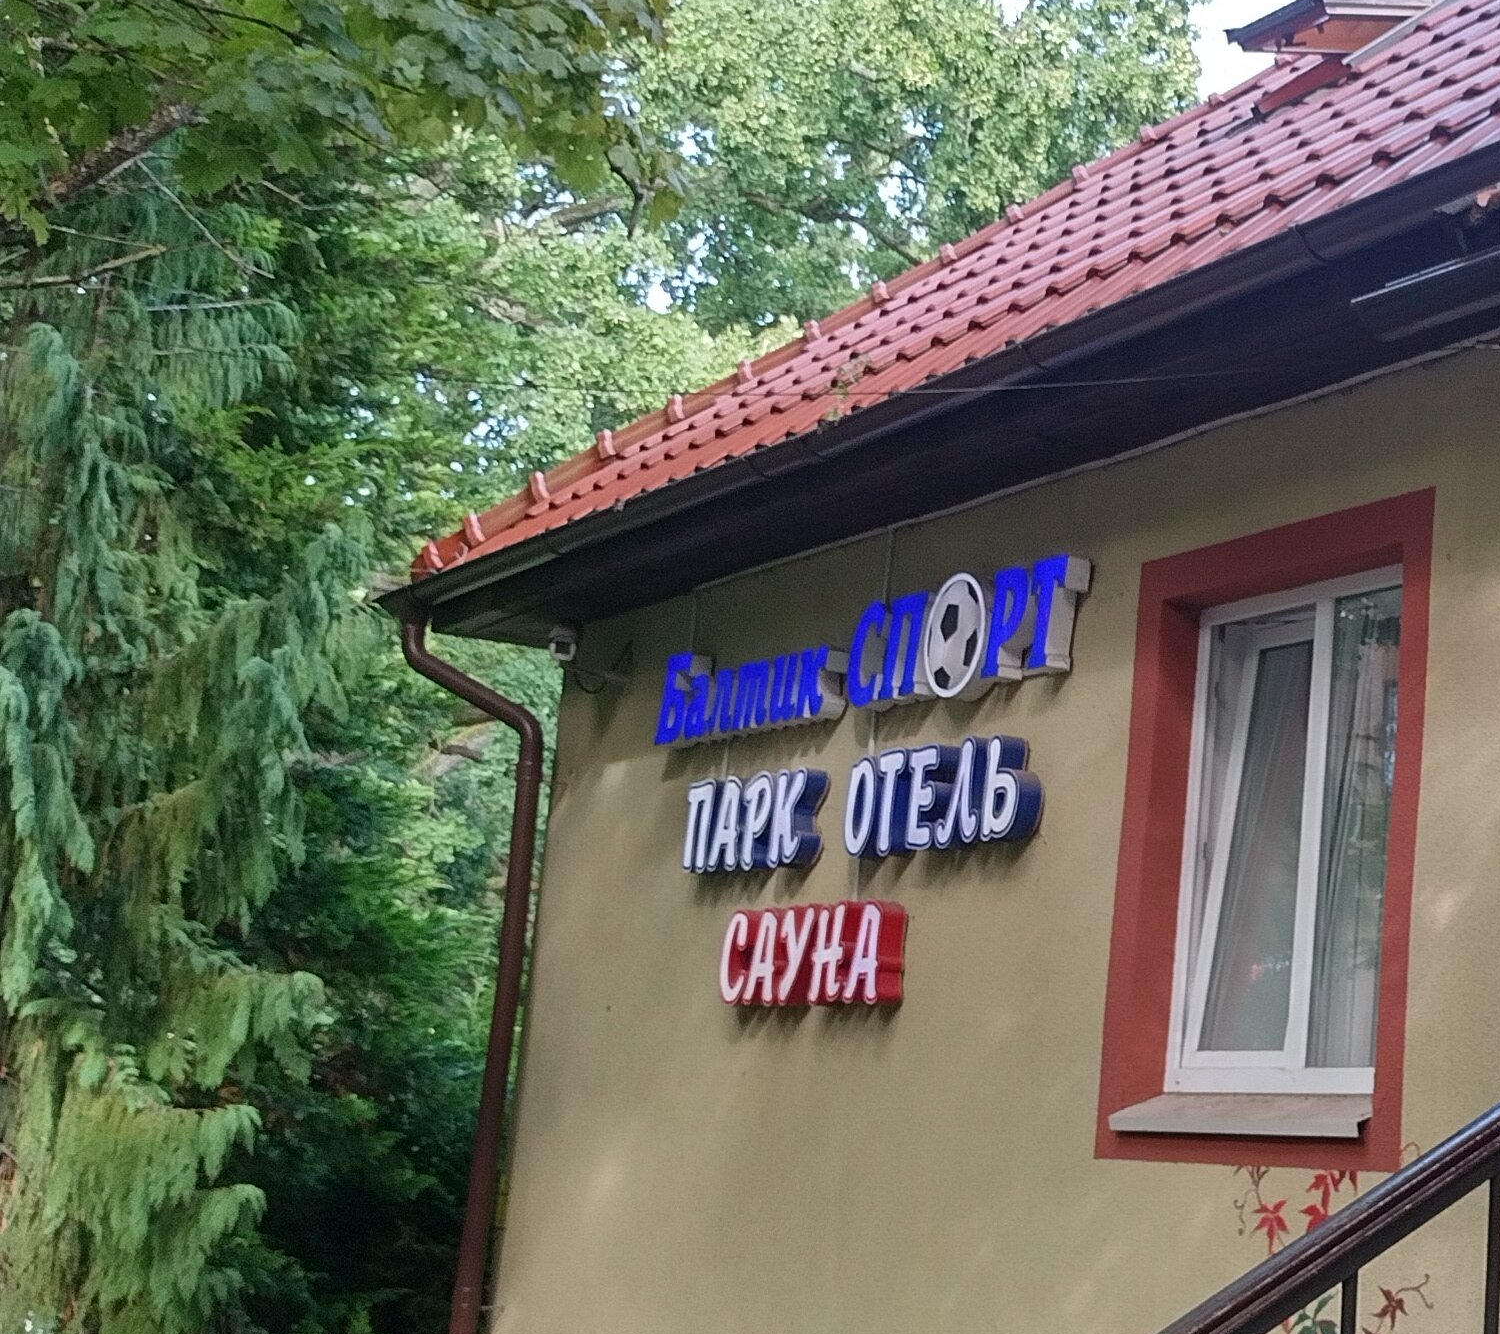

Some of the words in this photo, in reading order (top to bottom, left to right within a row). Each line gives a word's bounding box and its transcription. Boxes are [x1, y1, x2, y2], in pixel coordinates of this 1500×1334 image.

[654, 645, 832, 746] Балтик
[846, 553, 1074, 708] СПОРТ
[682, 767, 811, 873] ПАРК
[843, 735, 1025, 858] ОТЕЛЬ
[718, 900, 885, 1006] САУНА
